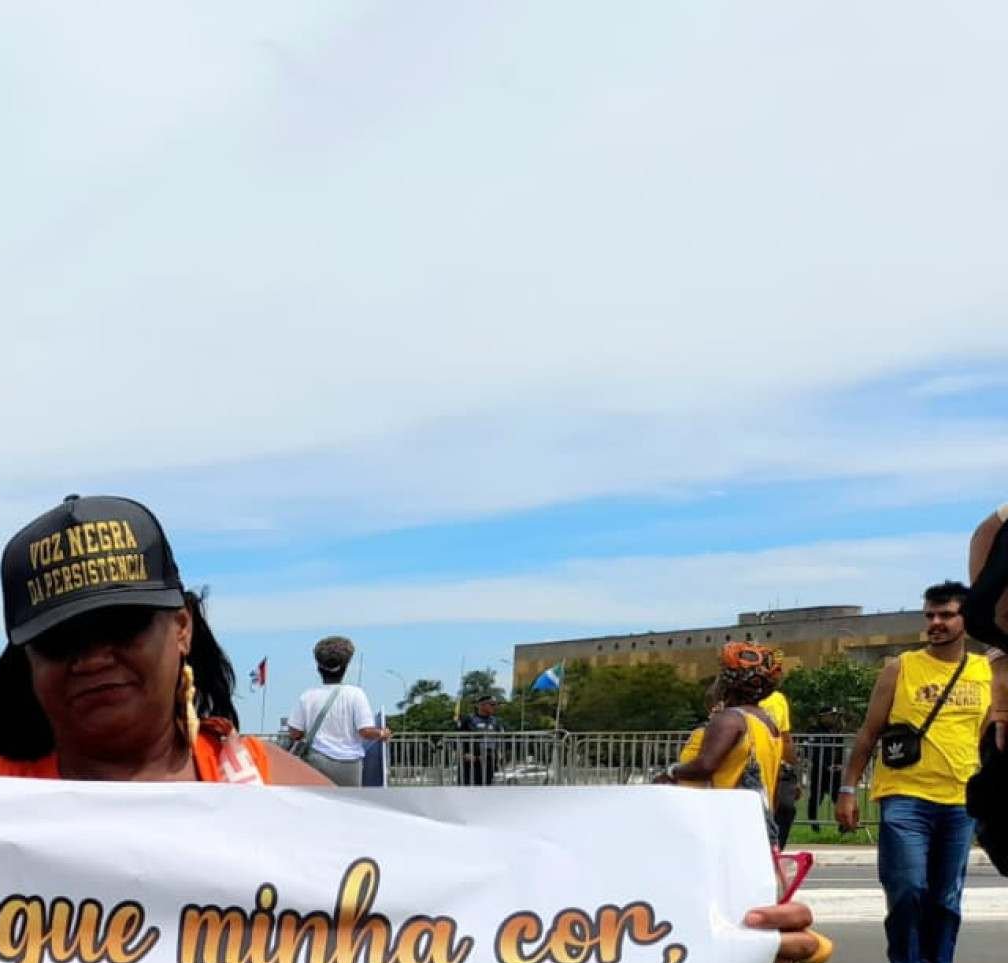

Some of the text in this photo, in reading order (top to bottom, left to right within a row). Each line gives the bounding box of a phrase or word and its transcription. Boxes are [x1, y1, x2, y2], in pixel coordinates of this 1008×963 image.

[30, 520, 138, 569] VOZ NEGRA
[27, 577, 45, 606] DA
